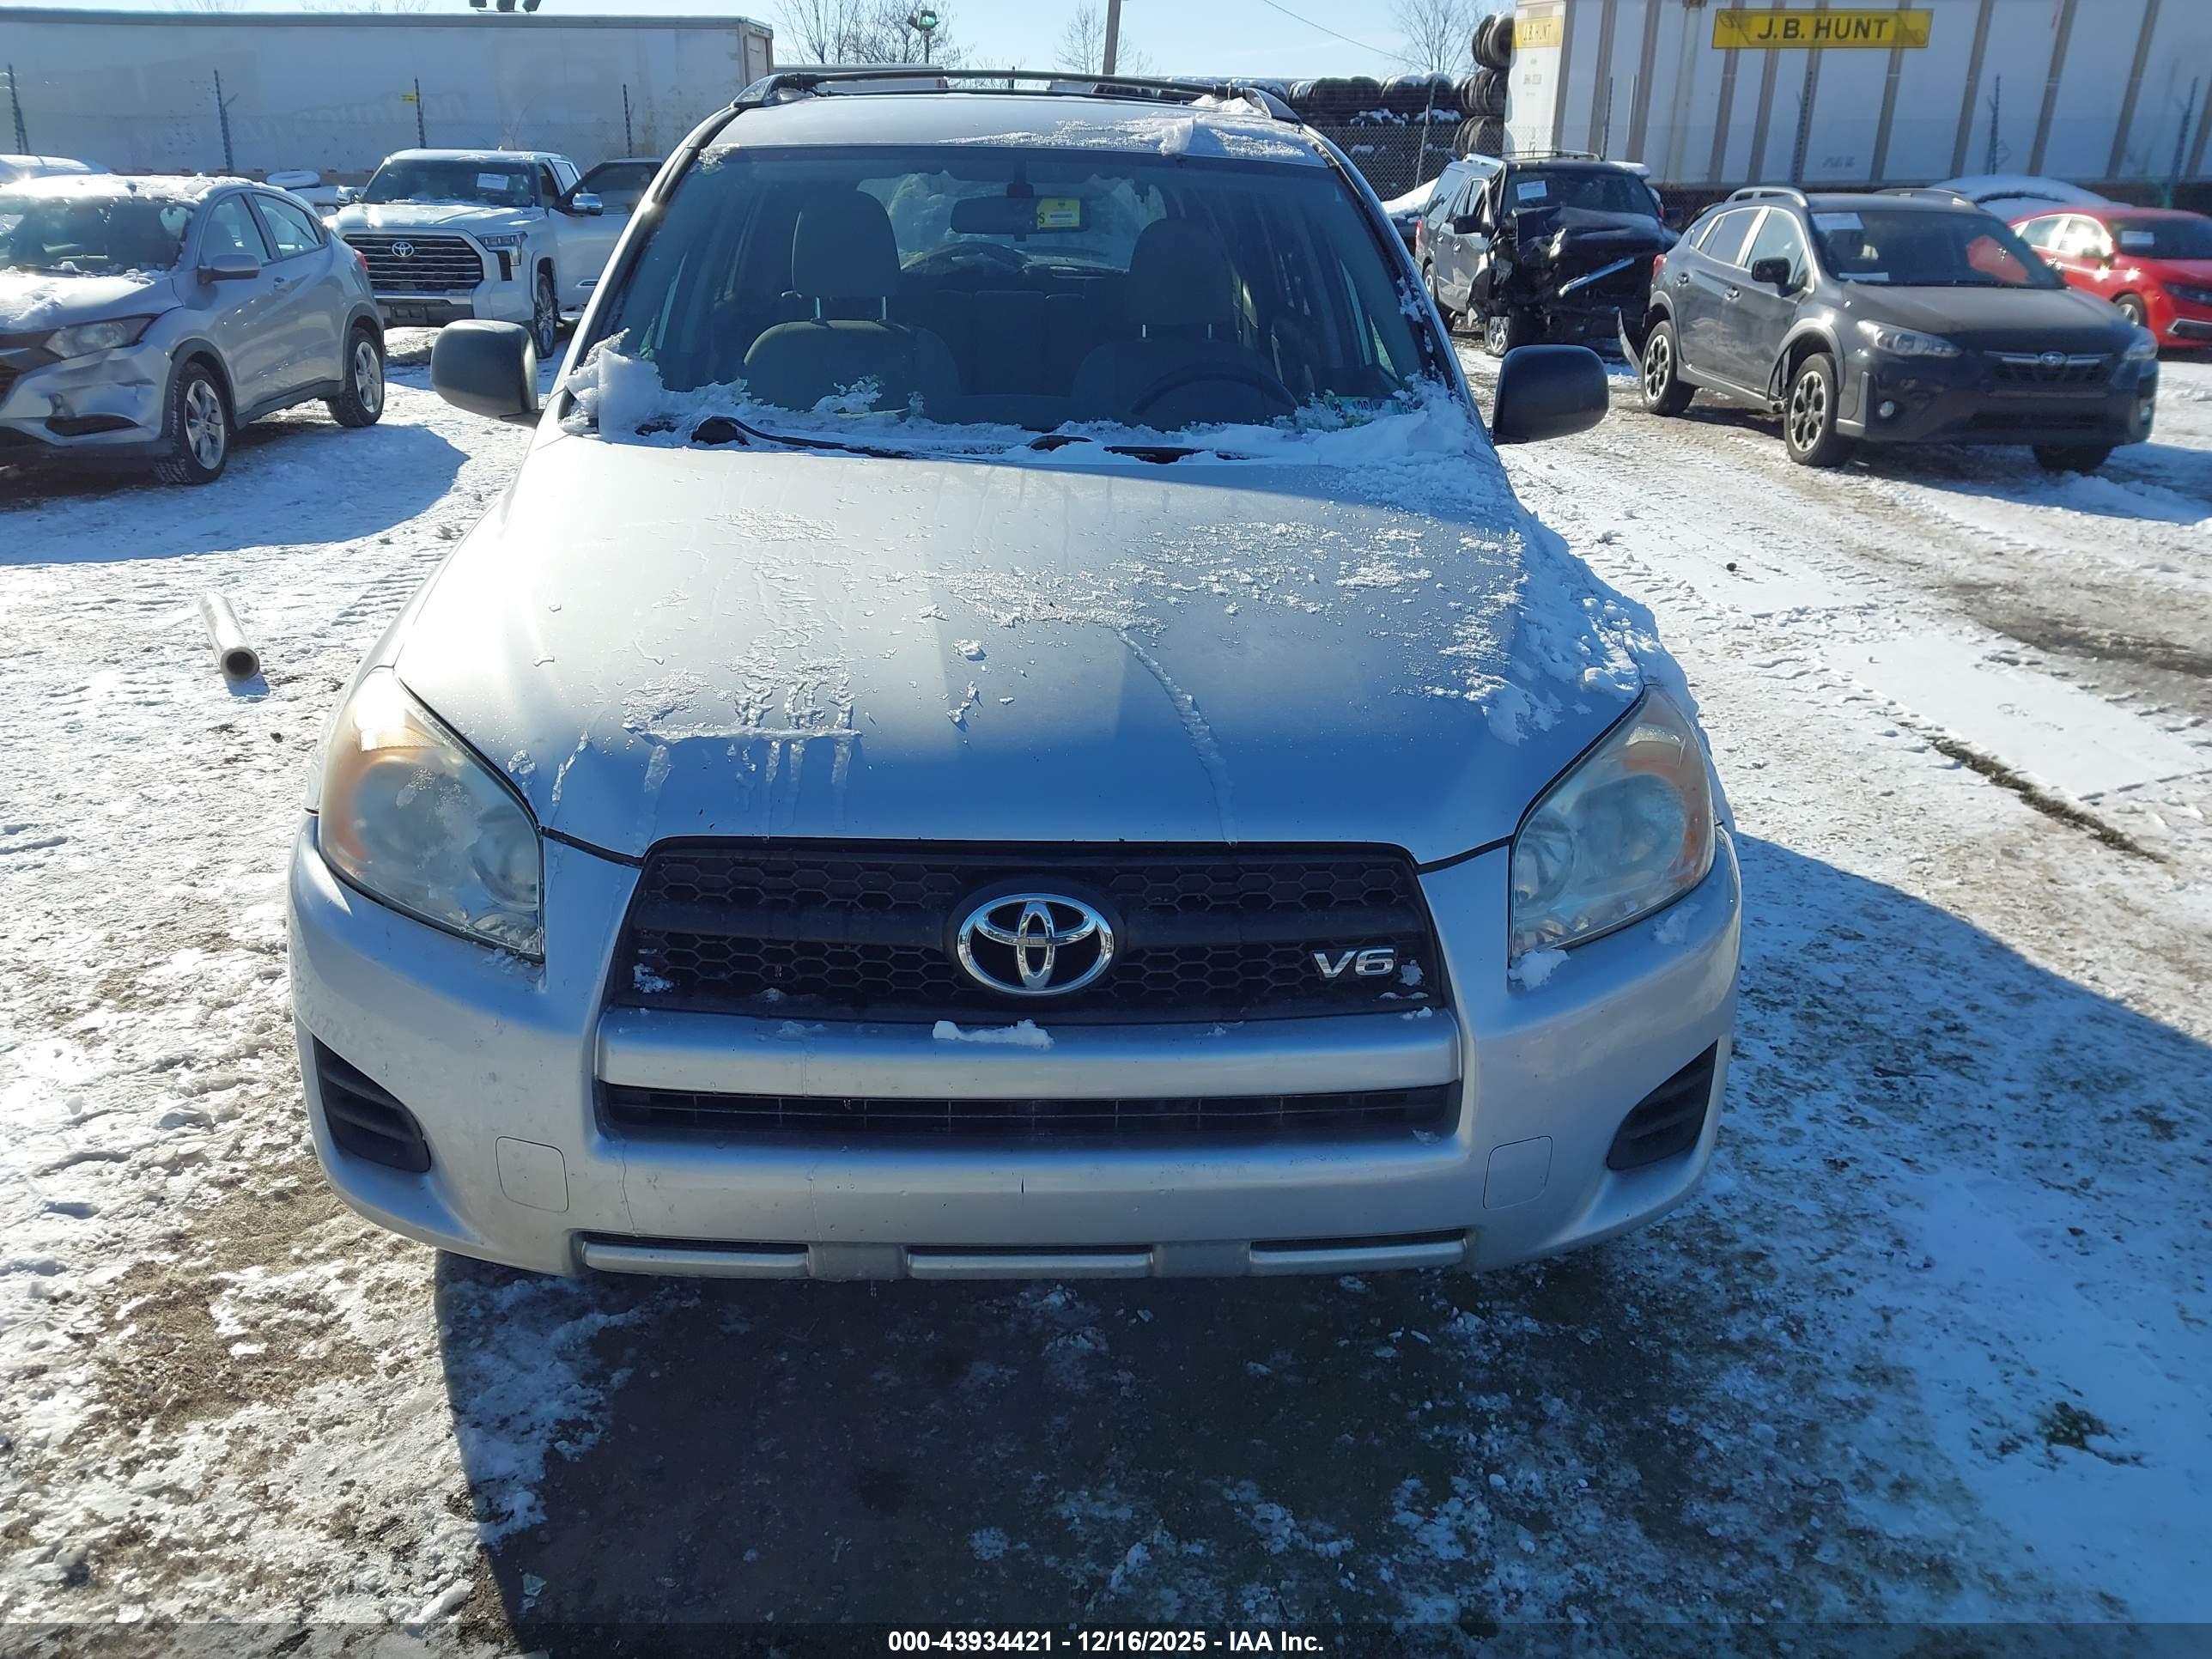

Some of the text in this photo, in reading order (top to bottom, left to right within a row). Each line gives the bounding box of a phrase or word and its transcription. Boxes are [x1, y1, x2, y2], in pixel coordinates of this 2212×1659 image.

[1757, 17, 1889, 40] J.B. HUNT
[1313, 948, 1395, 978] V6
